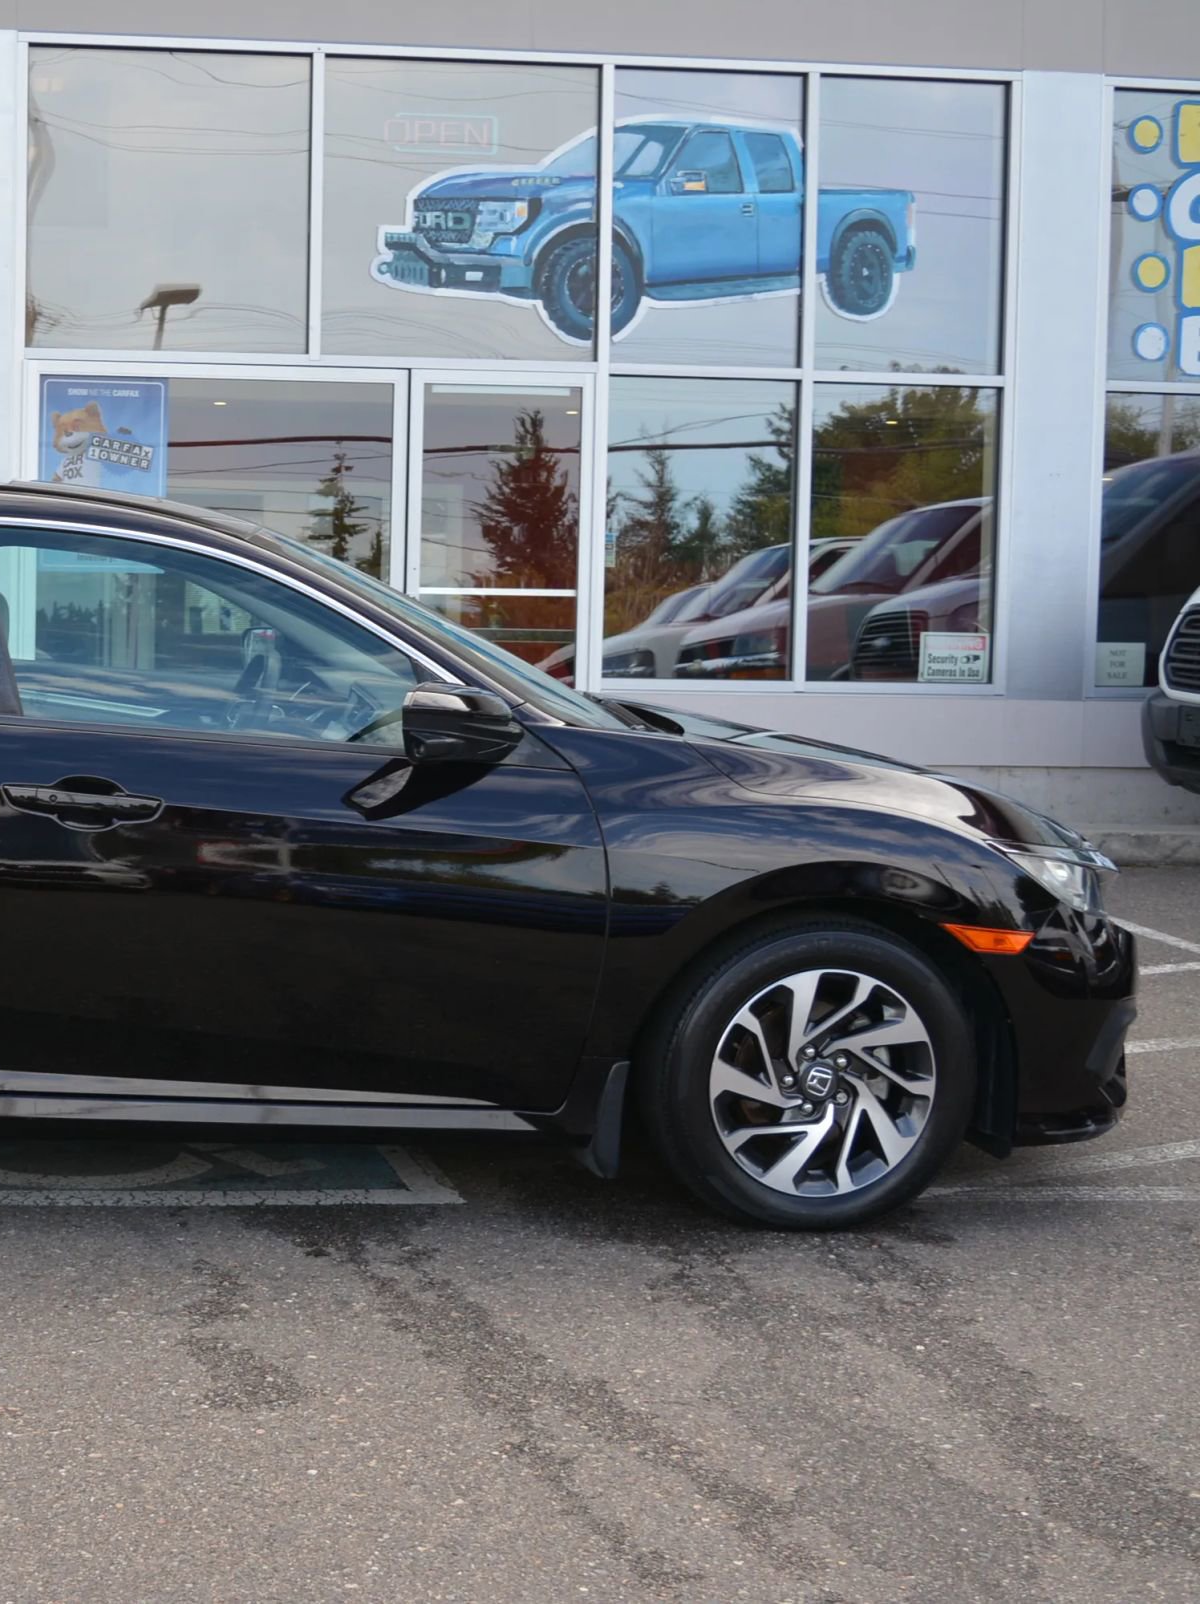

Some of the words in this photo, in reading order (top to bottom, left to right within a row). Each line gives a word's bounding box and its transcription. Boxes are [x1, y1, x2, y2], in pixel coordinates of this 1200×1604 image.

[384, 119, 490, 147] OPEN
[92, 436, 153, 459] CARFAX
[99, 451, 150, 470] OWNER
[927, 653, 959, 666] Security
[1109, 649, 1127, 657] NOT
[927, 666, 957, 677] Cameras
[1106, 672, 1127, 680] SALE
